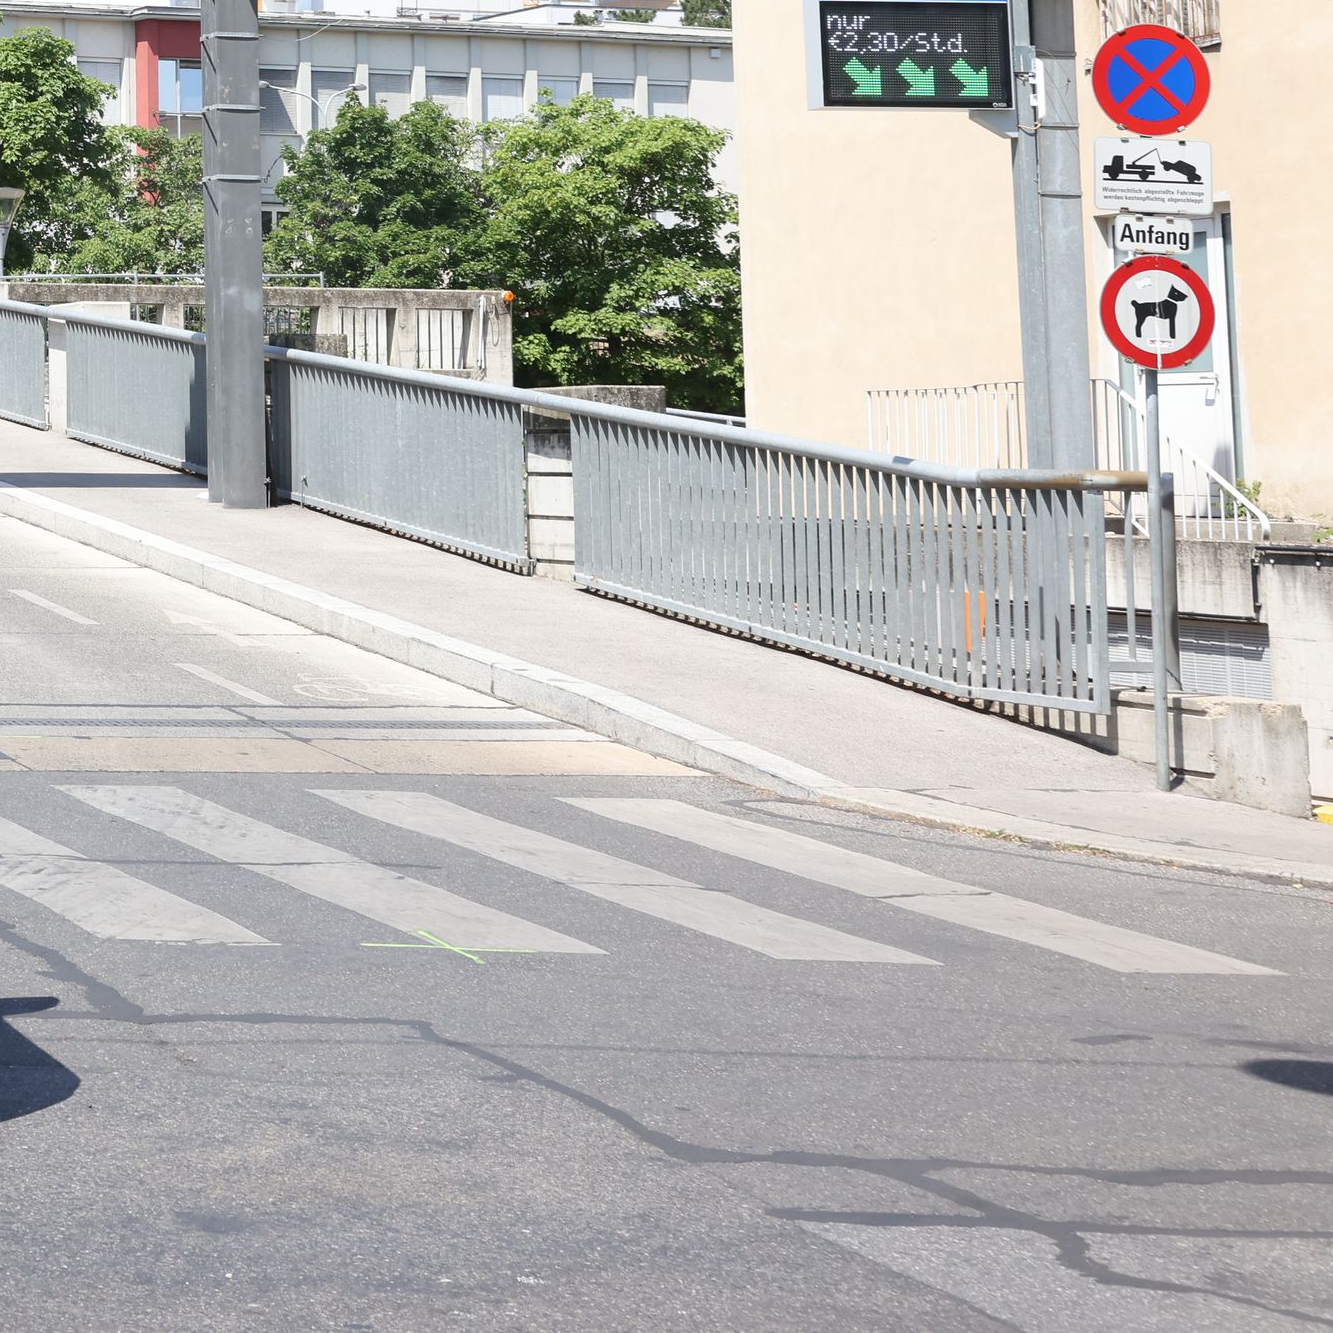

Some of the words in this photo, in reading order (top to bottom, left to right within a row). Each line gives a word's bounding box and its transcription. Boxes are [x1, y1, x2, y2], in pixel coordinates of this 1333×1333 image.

[826, 15, 871, 30] nur
[827, 32, 969, 54] €2,30/Std.
[1102, 186, 1142, 194] Widerrechtlich
[1176, 189, 1205, 197] Fahrzeuge
[1124, 194, 1166, 203] kostenpflichtig
[1167, 196, 1204, 204] abgeschleppt
[1119, 223, 1190, 251] Anfang
